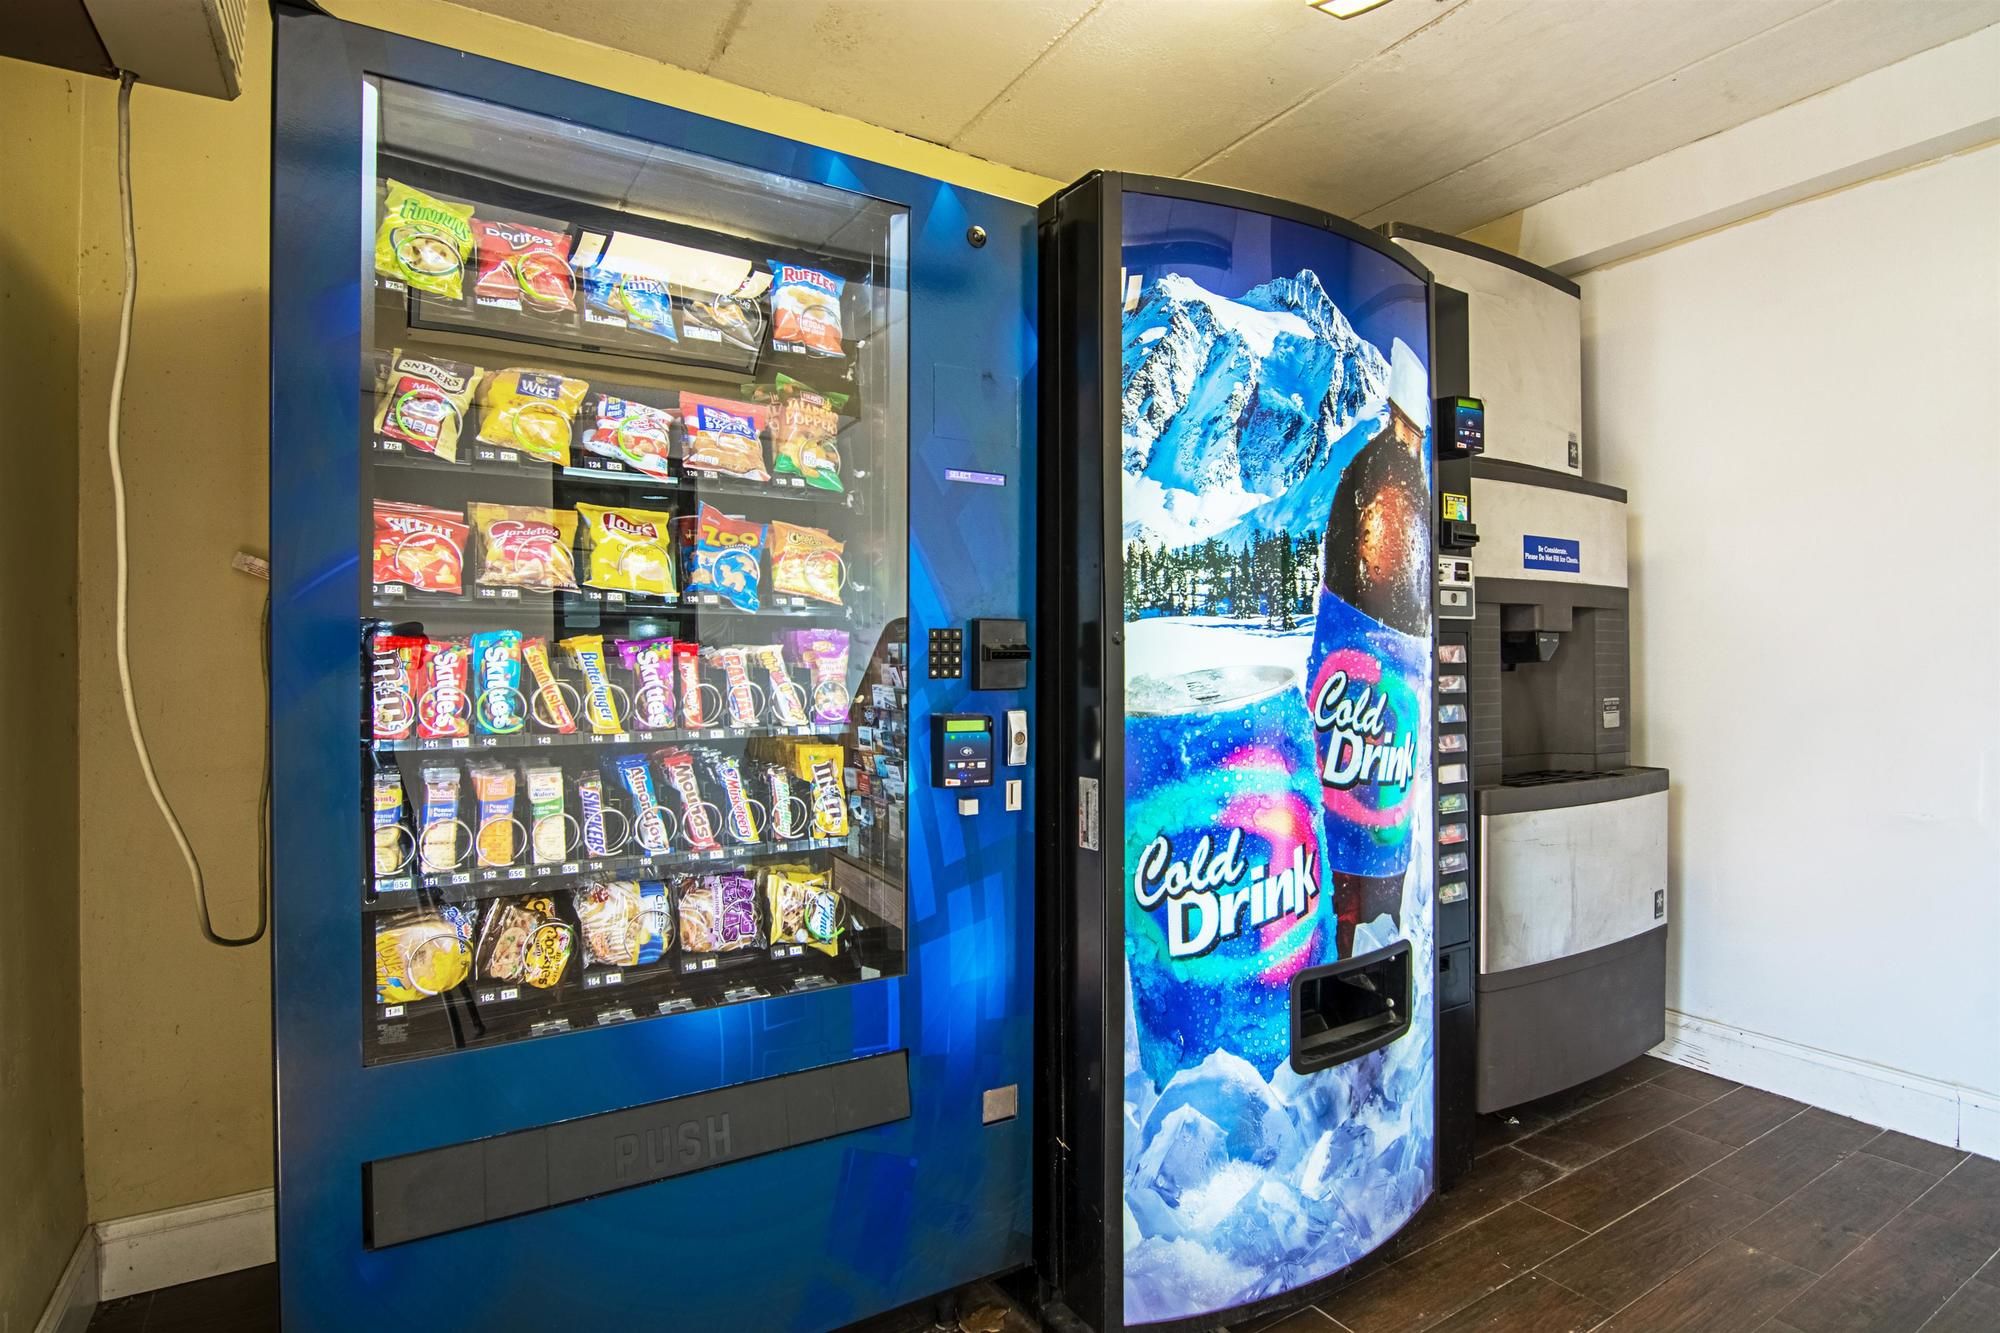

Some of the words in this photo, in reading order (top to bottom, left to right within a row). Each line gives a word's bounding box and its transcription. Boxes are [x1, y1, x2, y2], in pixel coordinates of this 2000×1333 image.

[485, 227, 553, 247] Doritos
[782, 267, 836, 292] RUFFLES
[521, 378, 556, 398] WISE
[481, 451, 494, 459] 122
[588, 461, 601, 469] 124
[489, 521, 560, 550] Gardetto's
[702, 525, 758, 547] ZOO
[1525, 552, 1538, 560] Please
[433, 652, 459, 728] Skittles
[485, 646, 510, 729] Skittles
[581, 652, 613, 721] Butterfinger
[637, 650, 667, 727] Skittles
[1314, 670, 1388, 734] Cold
[424, 740, 439, 748] 141
[482, 738, 497, 746] 142
[537, 737, 551, 745] 143
[733, 728, 745, 736] 147
[1323, 728, 1416, 789] Drink
[630, 767, 657, 821] Almond
[674, 764, 710, 840] Mounds
[727, 775, 751, 837] Musketeers
[582, 790, 606, 855] SNICKERS
[537, 867, 551, 875] 153
[590, 862, 603, 870] 154
[1135, 829, 1247, 907] Cold
[1167, 845, 1318, 957] Drink
[587, 977, 600, 985] 164
[480, 993, 495, 1001] 162
[614, 1112, 732, 1180] PUSH
